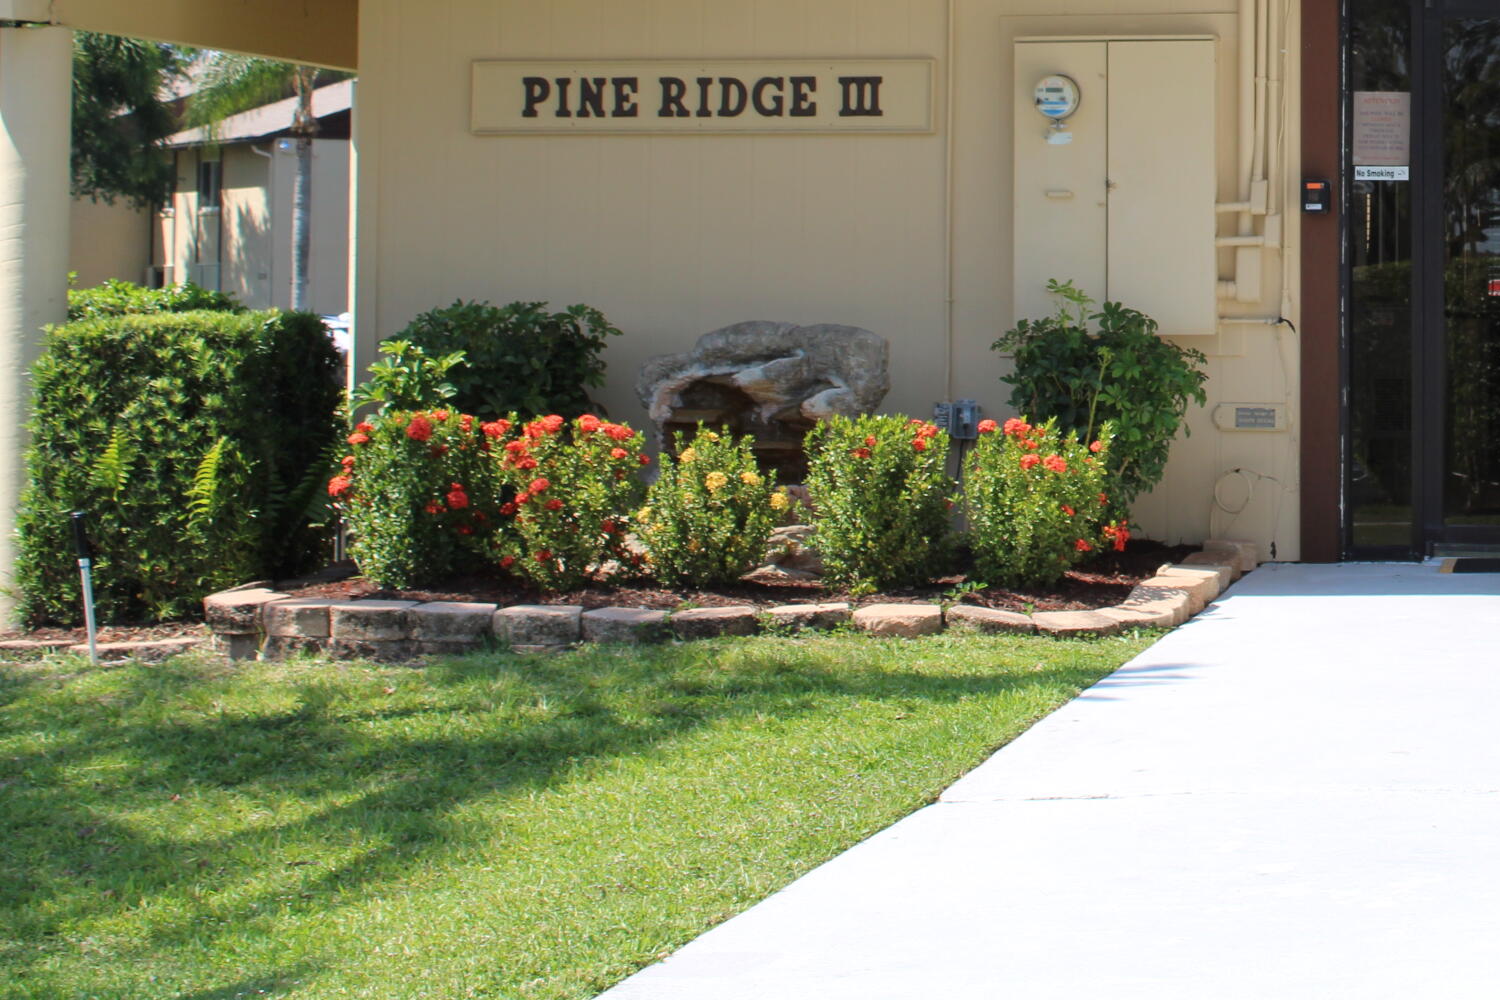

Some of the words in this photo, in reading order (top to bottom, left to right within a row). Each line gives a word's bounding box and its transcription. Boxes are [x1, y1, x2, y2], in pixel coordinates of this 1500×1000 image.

[522, 77, 638, 118] PINE
[657, 76, 817, 118] RIDGE
[838, 76, 883, 117] III
[1356, 169, 1365, 177] No
[1366, 169, 1395, 179] Smoking
